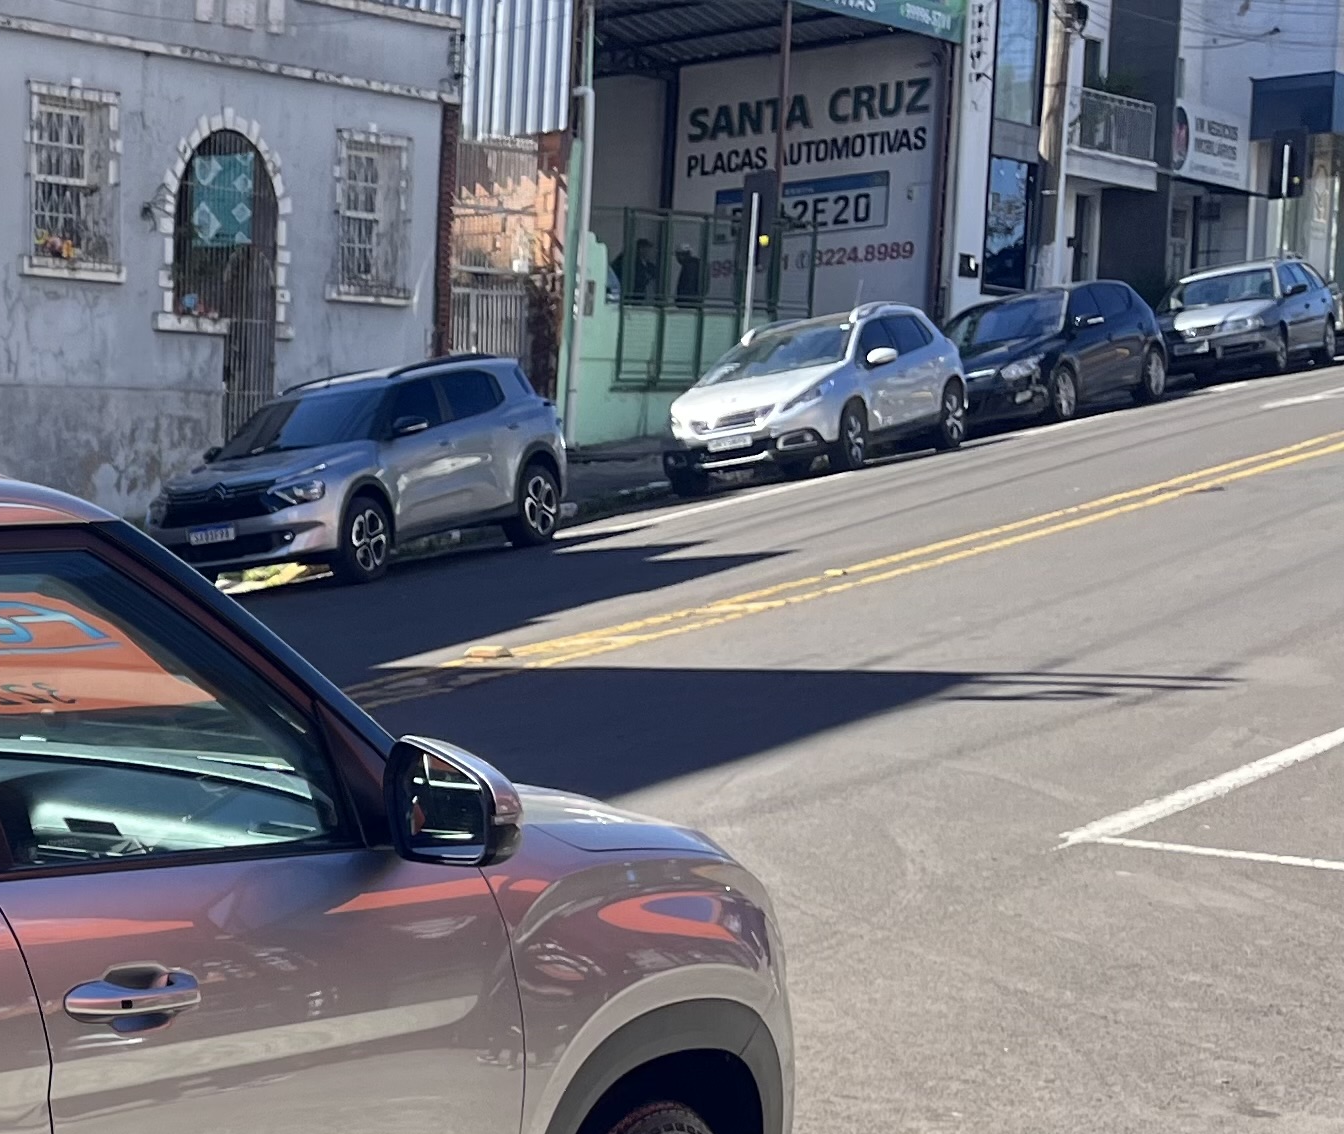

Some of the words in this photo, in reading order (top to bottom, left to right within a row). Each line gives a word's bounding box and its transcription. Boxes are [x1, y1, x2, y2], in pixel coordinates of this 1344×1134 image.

[687, 94, 814, 143] SANTA
[828, 77, 932, 125] CRUZ
[687, 146, 768, 178] PLACAS
